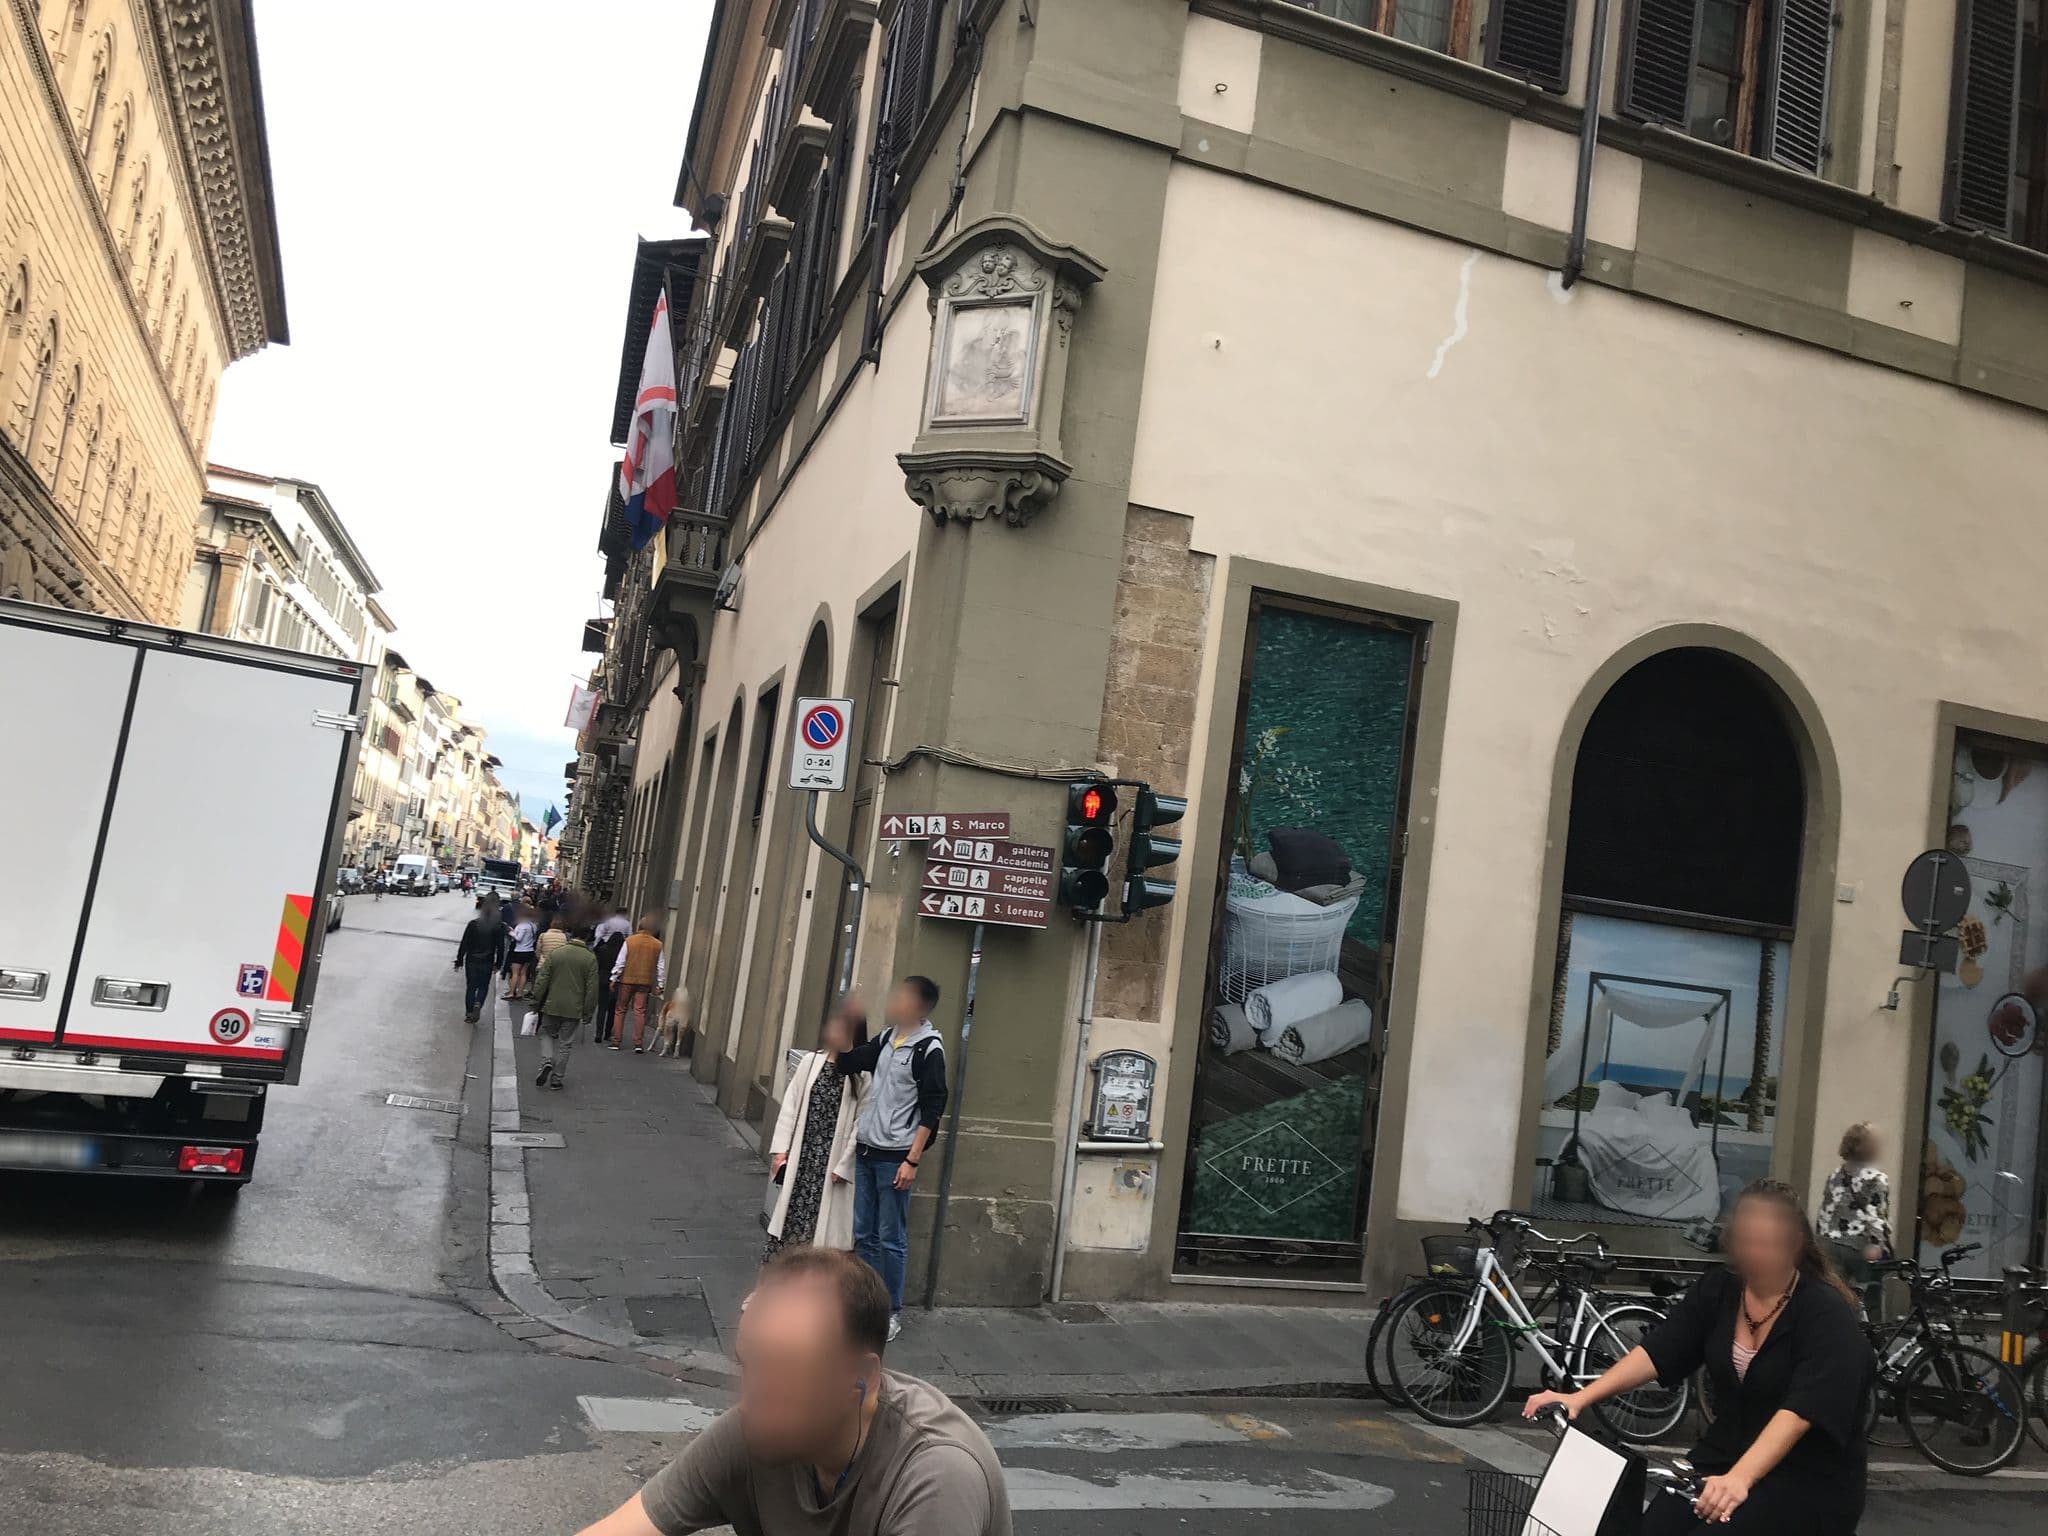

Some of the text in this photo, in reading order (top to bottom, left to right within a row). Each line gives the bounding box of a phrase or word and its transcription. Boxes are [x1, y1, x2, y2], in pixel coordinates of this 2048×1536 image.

[951, 820, 1005, 830] S. Marco
[1012, 847, 1049, 857] galleria
[996, 856, 1049, 870] Accademia
[1004, 873, 1048, 887] cappelle
[1003, 884, 1044, 896] Medicee
[994, 904, 1044, 918] S. Lorenzo
[220, 1018, 240, 1034] 90
[1242, 1156, 1312, 1175] FRETTE
